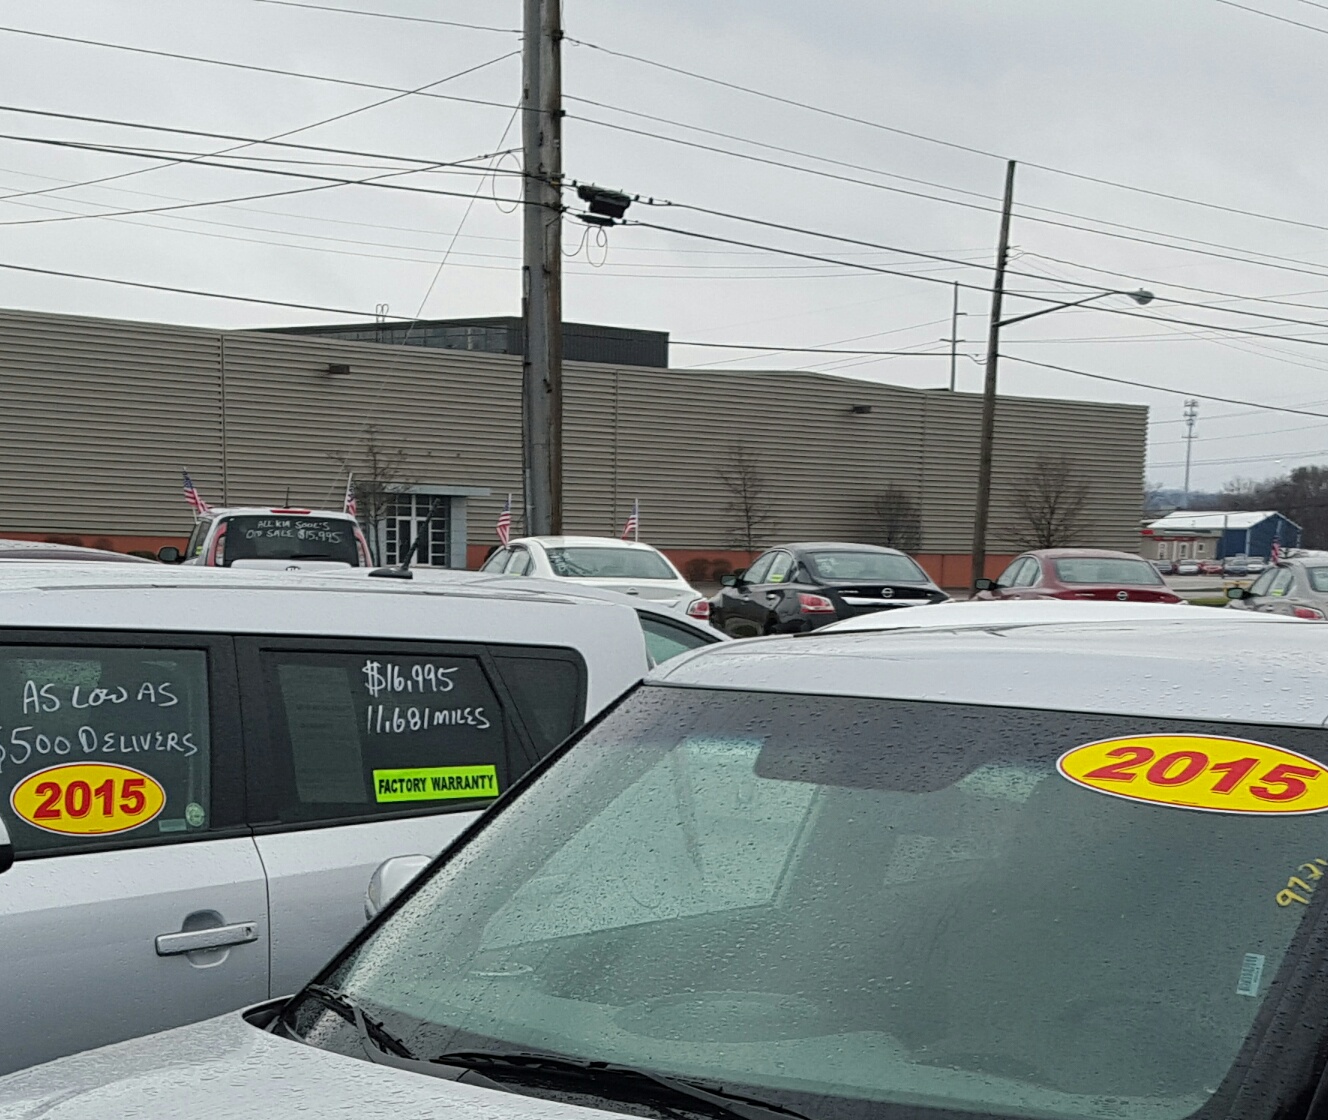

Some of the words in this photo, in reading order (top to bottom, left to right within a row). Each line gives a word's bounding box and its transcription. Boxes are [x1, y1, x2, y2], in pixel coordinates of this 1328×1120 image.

[266, 529, 295, 538] SALE
[362, 660, 460, 698] $16,995
[23, 680, 61, 714] AS
[72, 685, 128, 709] LOW
[137, 682, 179, 707] AS
[433, 707, 491, 730] MILES
[78, 726, 198, 757] DELIVERS
[378, 776, 427, 795] FACTORY
[430, 773, 495, 792] WARRANTY
[1081, 745, 1323, 803] 2015
[32, 778, 147, 821] 2015
